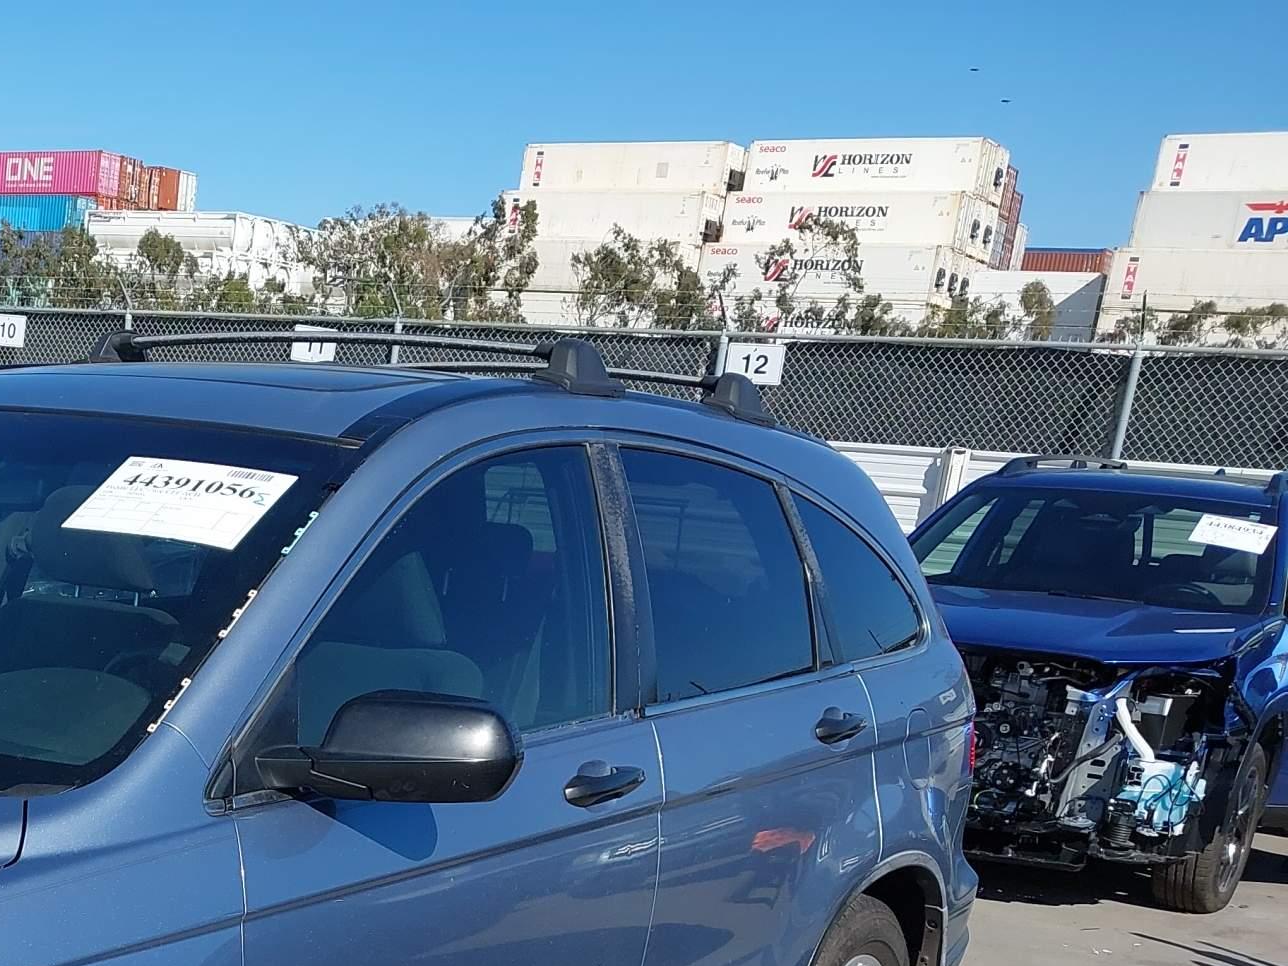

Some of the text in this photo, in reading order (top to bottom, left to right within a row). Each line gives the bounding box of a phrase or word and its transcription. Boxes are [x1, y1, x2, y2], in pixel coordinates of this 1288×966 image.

[759, 145, 787, 153] seaco
[839, 153, 913, 165] HORIZON
[5, 157, 54, 181] ONE
[735, 196, 764, 204] seaco
[817, 206, 890, 217] HORIZON
[710, 247, 738, 255] seaco
[792, 259, 864, 273] HORIZON
[0, 322, 16, 339] 10
[742, 353, 769, 375] 12
[123, 473, 258, 498] 44391056
